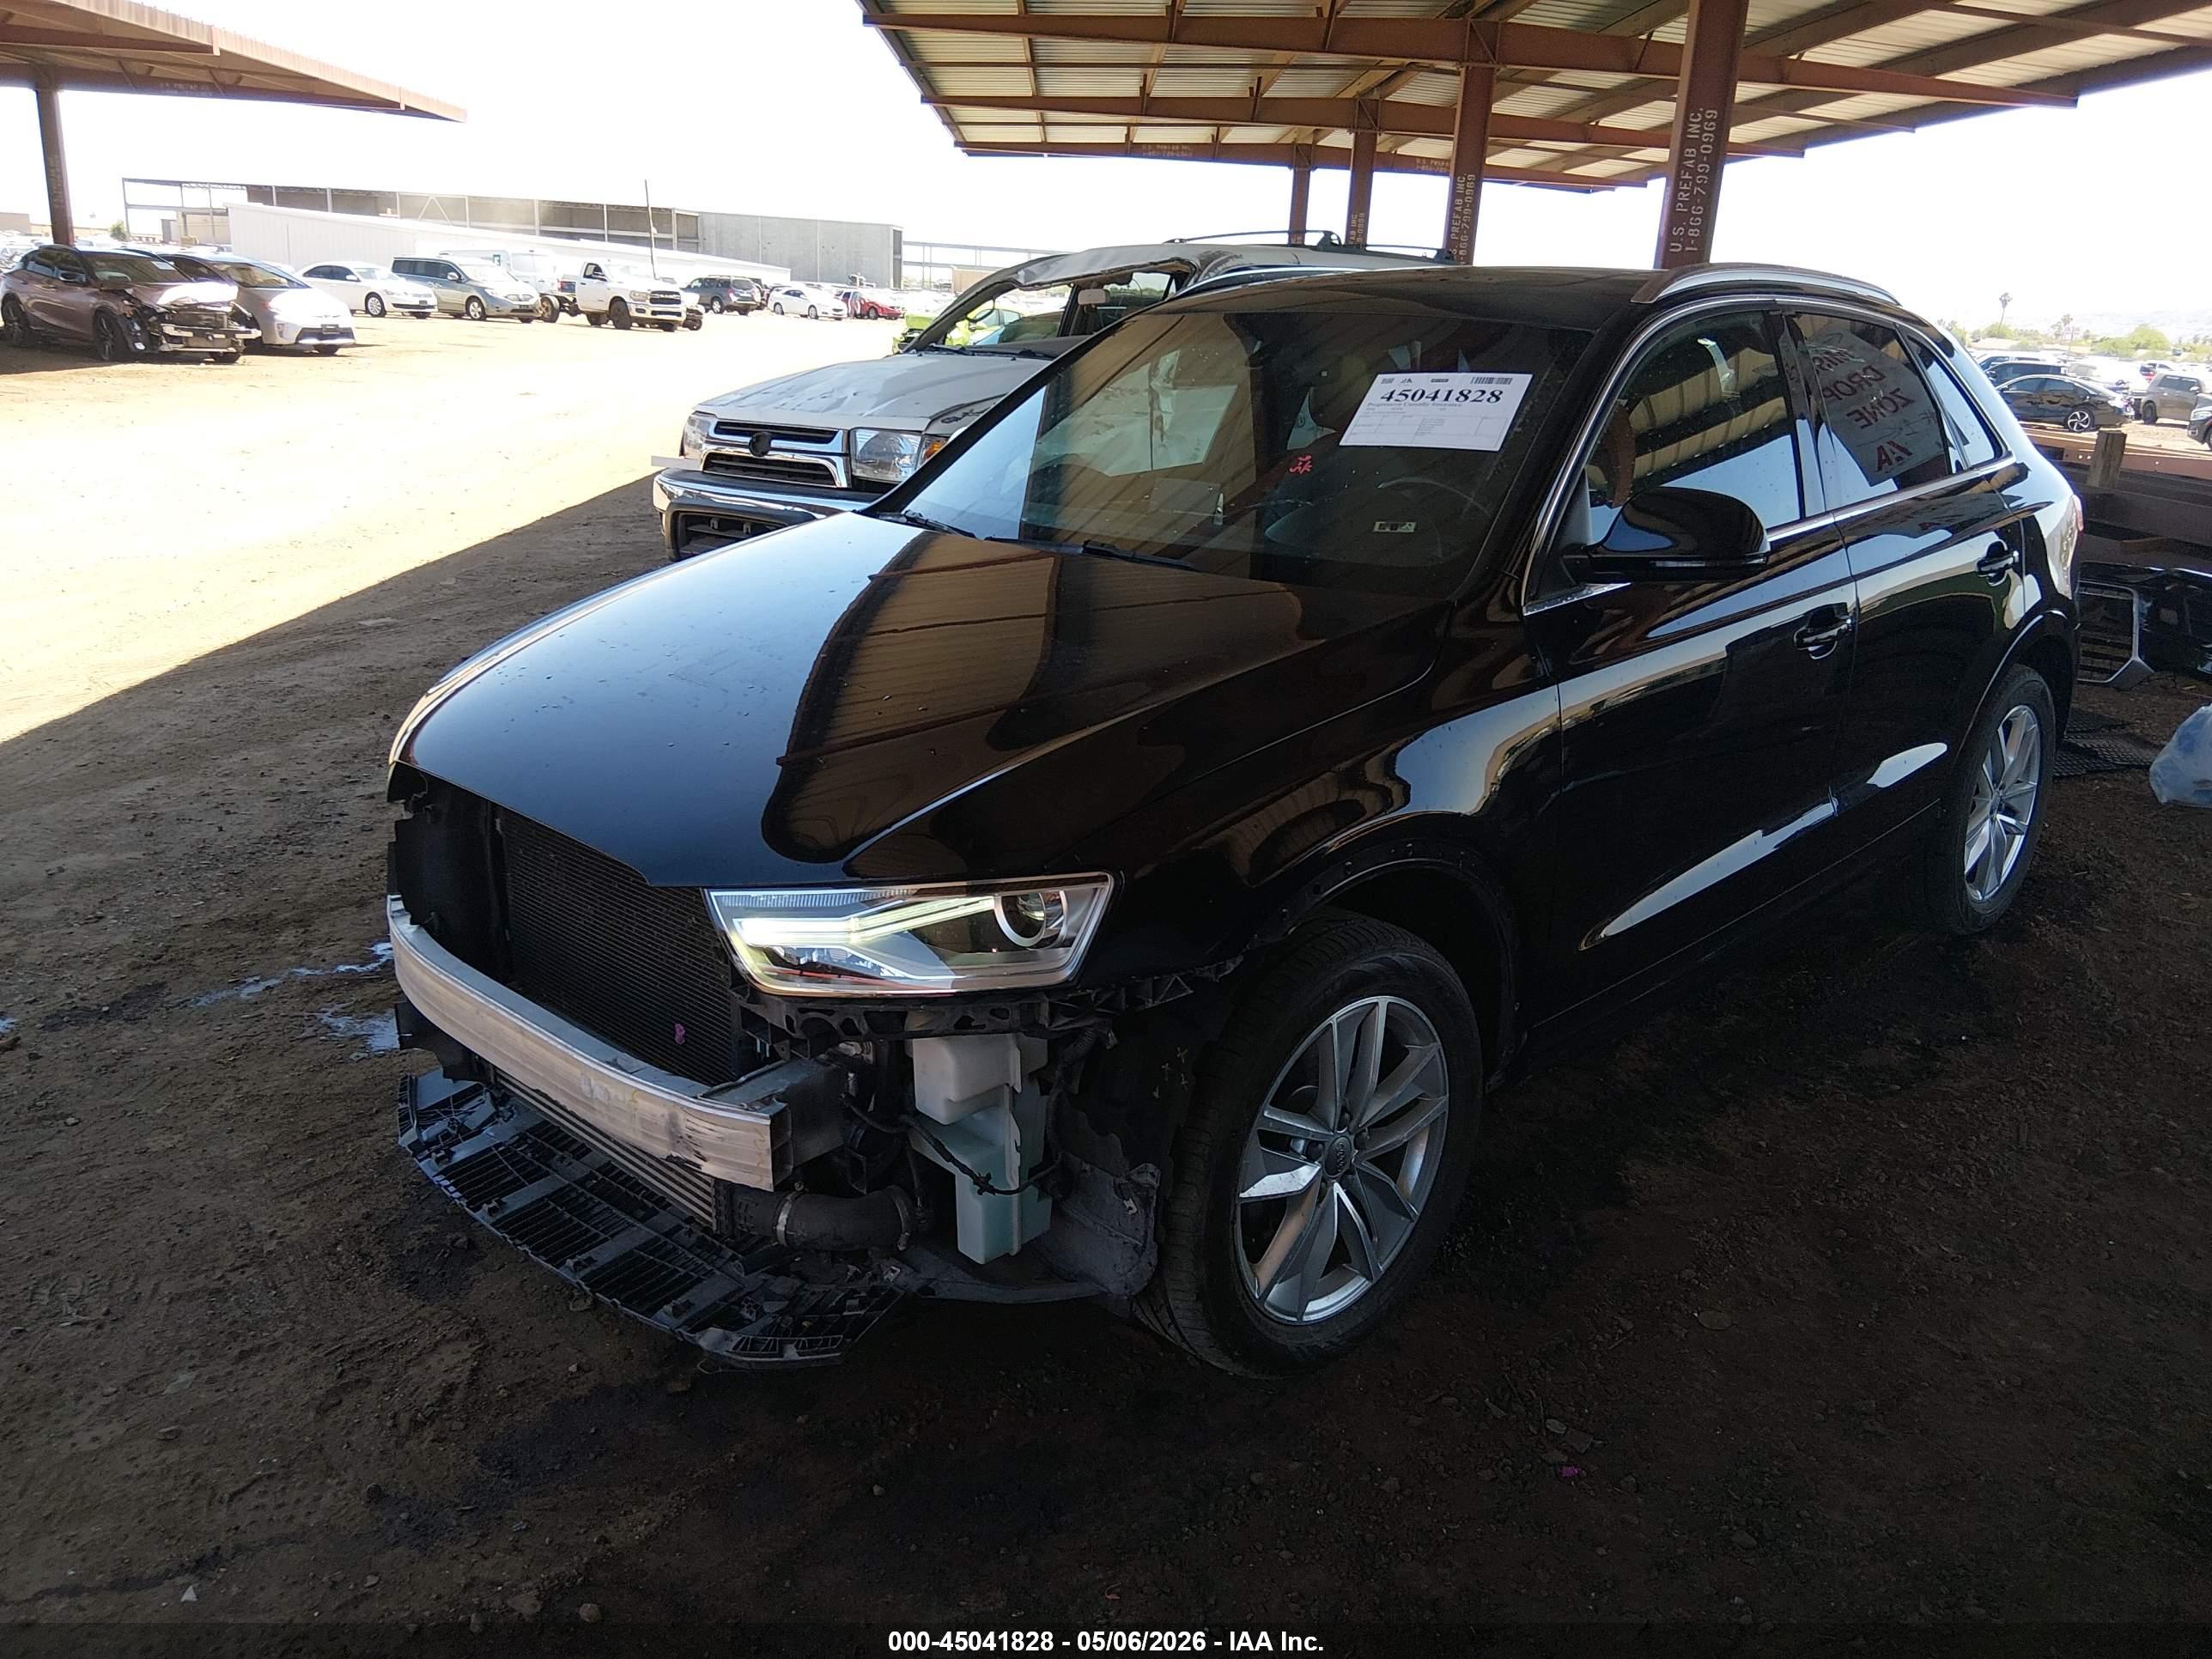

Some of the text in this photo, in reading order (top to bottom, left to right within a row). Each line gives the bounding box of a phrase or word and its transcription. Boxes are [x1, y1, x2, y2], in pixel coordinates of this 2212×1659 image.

[1455, 173, 1467, 193] INC.
[1669, 107, 1704, 252] U.S. PREFAB INC.
[1685, 109, 1718, 252] 1-866-799-0969
[1450, 198, 1463, 240] PREFAB
[1380, 388, 1504, 404] 45041828
